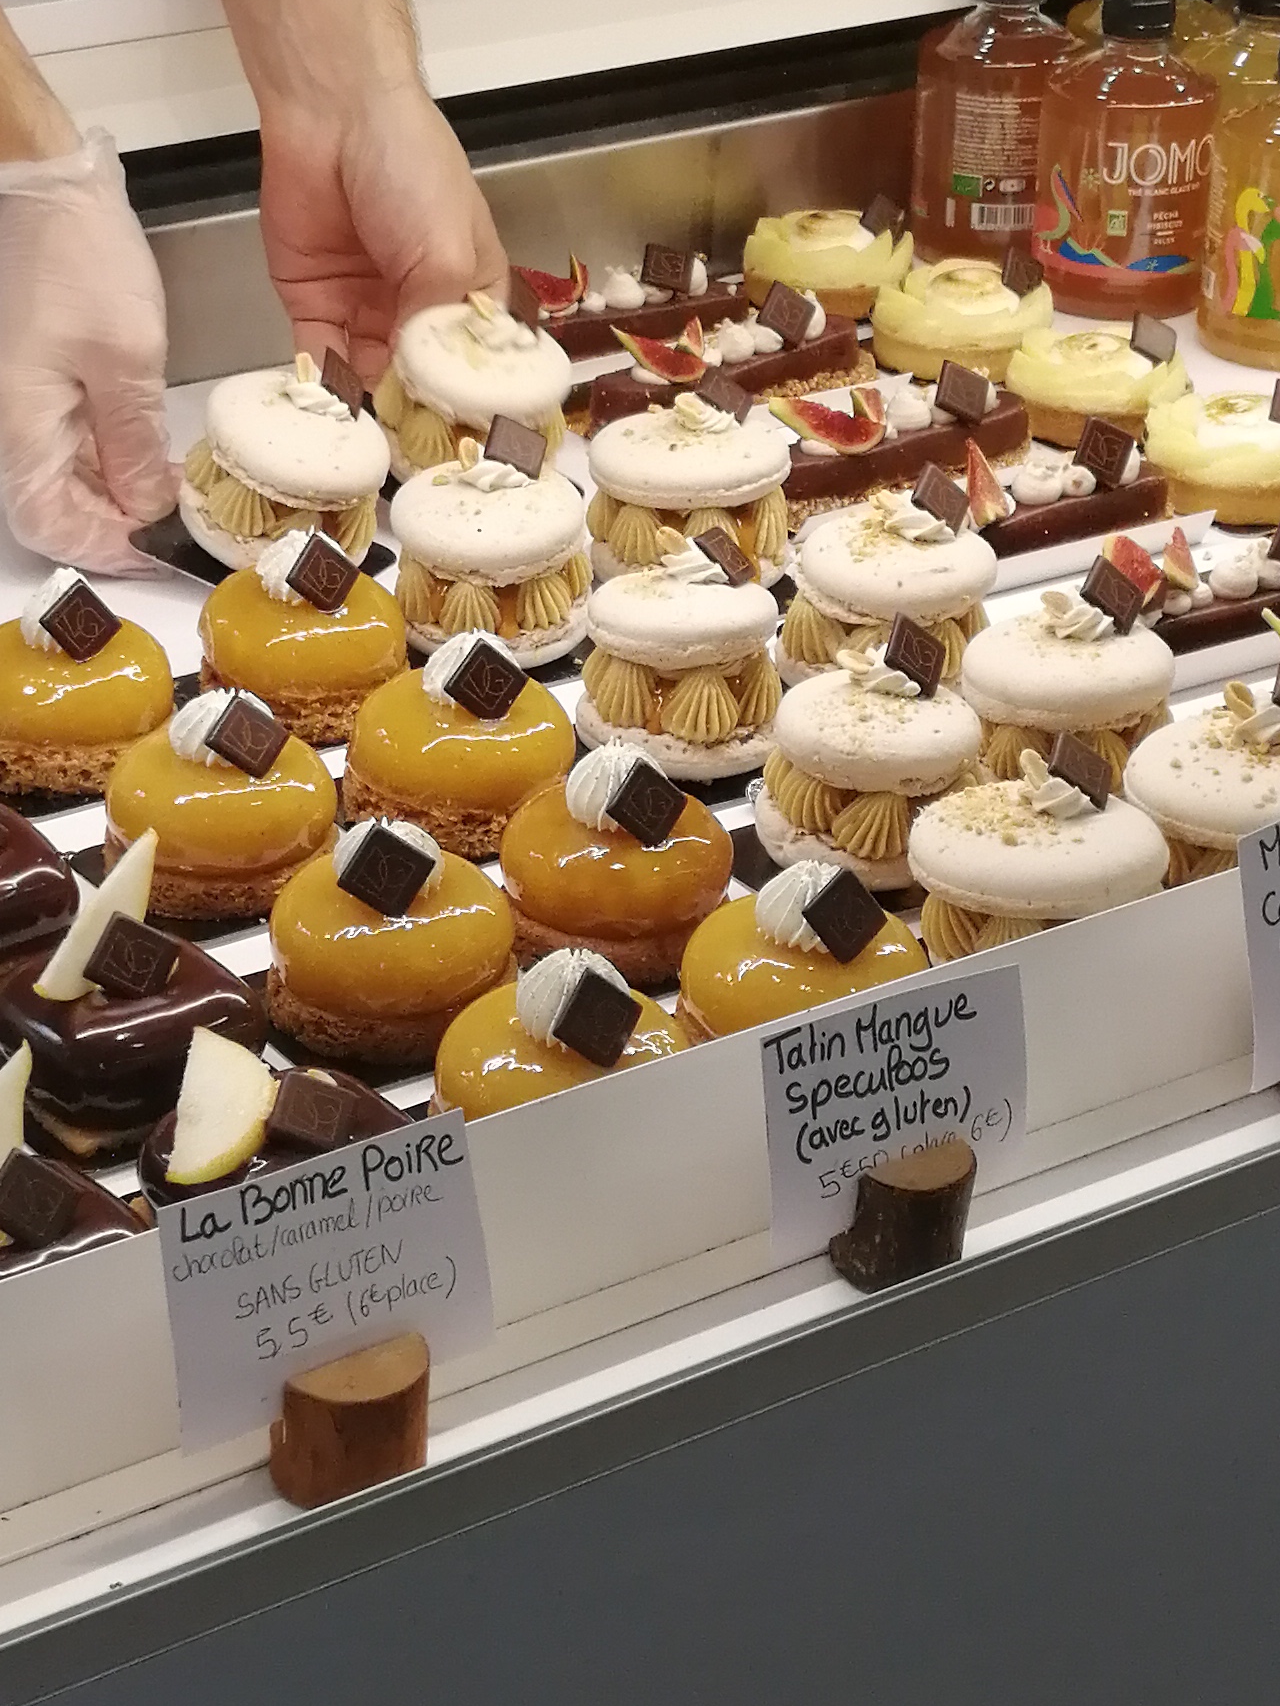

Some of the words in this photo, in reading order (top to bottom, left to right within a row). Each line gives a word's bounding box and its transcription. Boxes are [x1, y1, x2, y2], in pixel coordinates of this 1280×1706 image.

[763, 1022, 846, 1075] Tatin
[855, 992, 978, 1054] Mangue
[795, 1121, 867, 1165] (avec
[870, 1085, 972, 1143] gluten)
[180, 1205, 232, 1244] La
[239, 1164, 350, 1226] Bonne
[235, 1273, 302, 1321] SANS
[308, 1238, 404, 1294] GLUTEN
